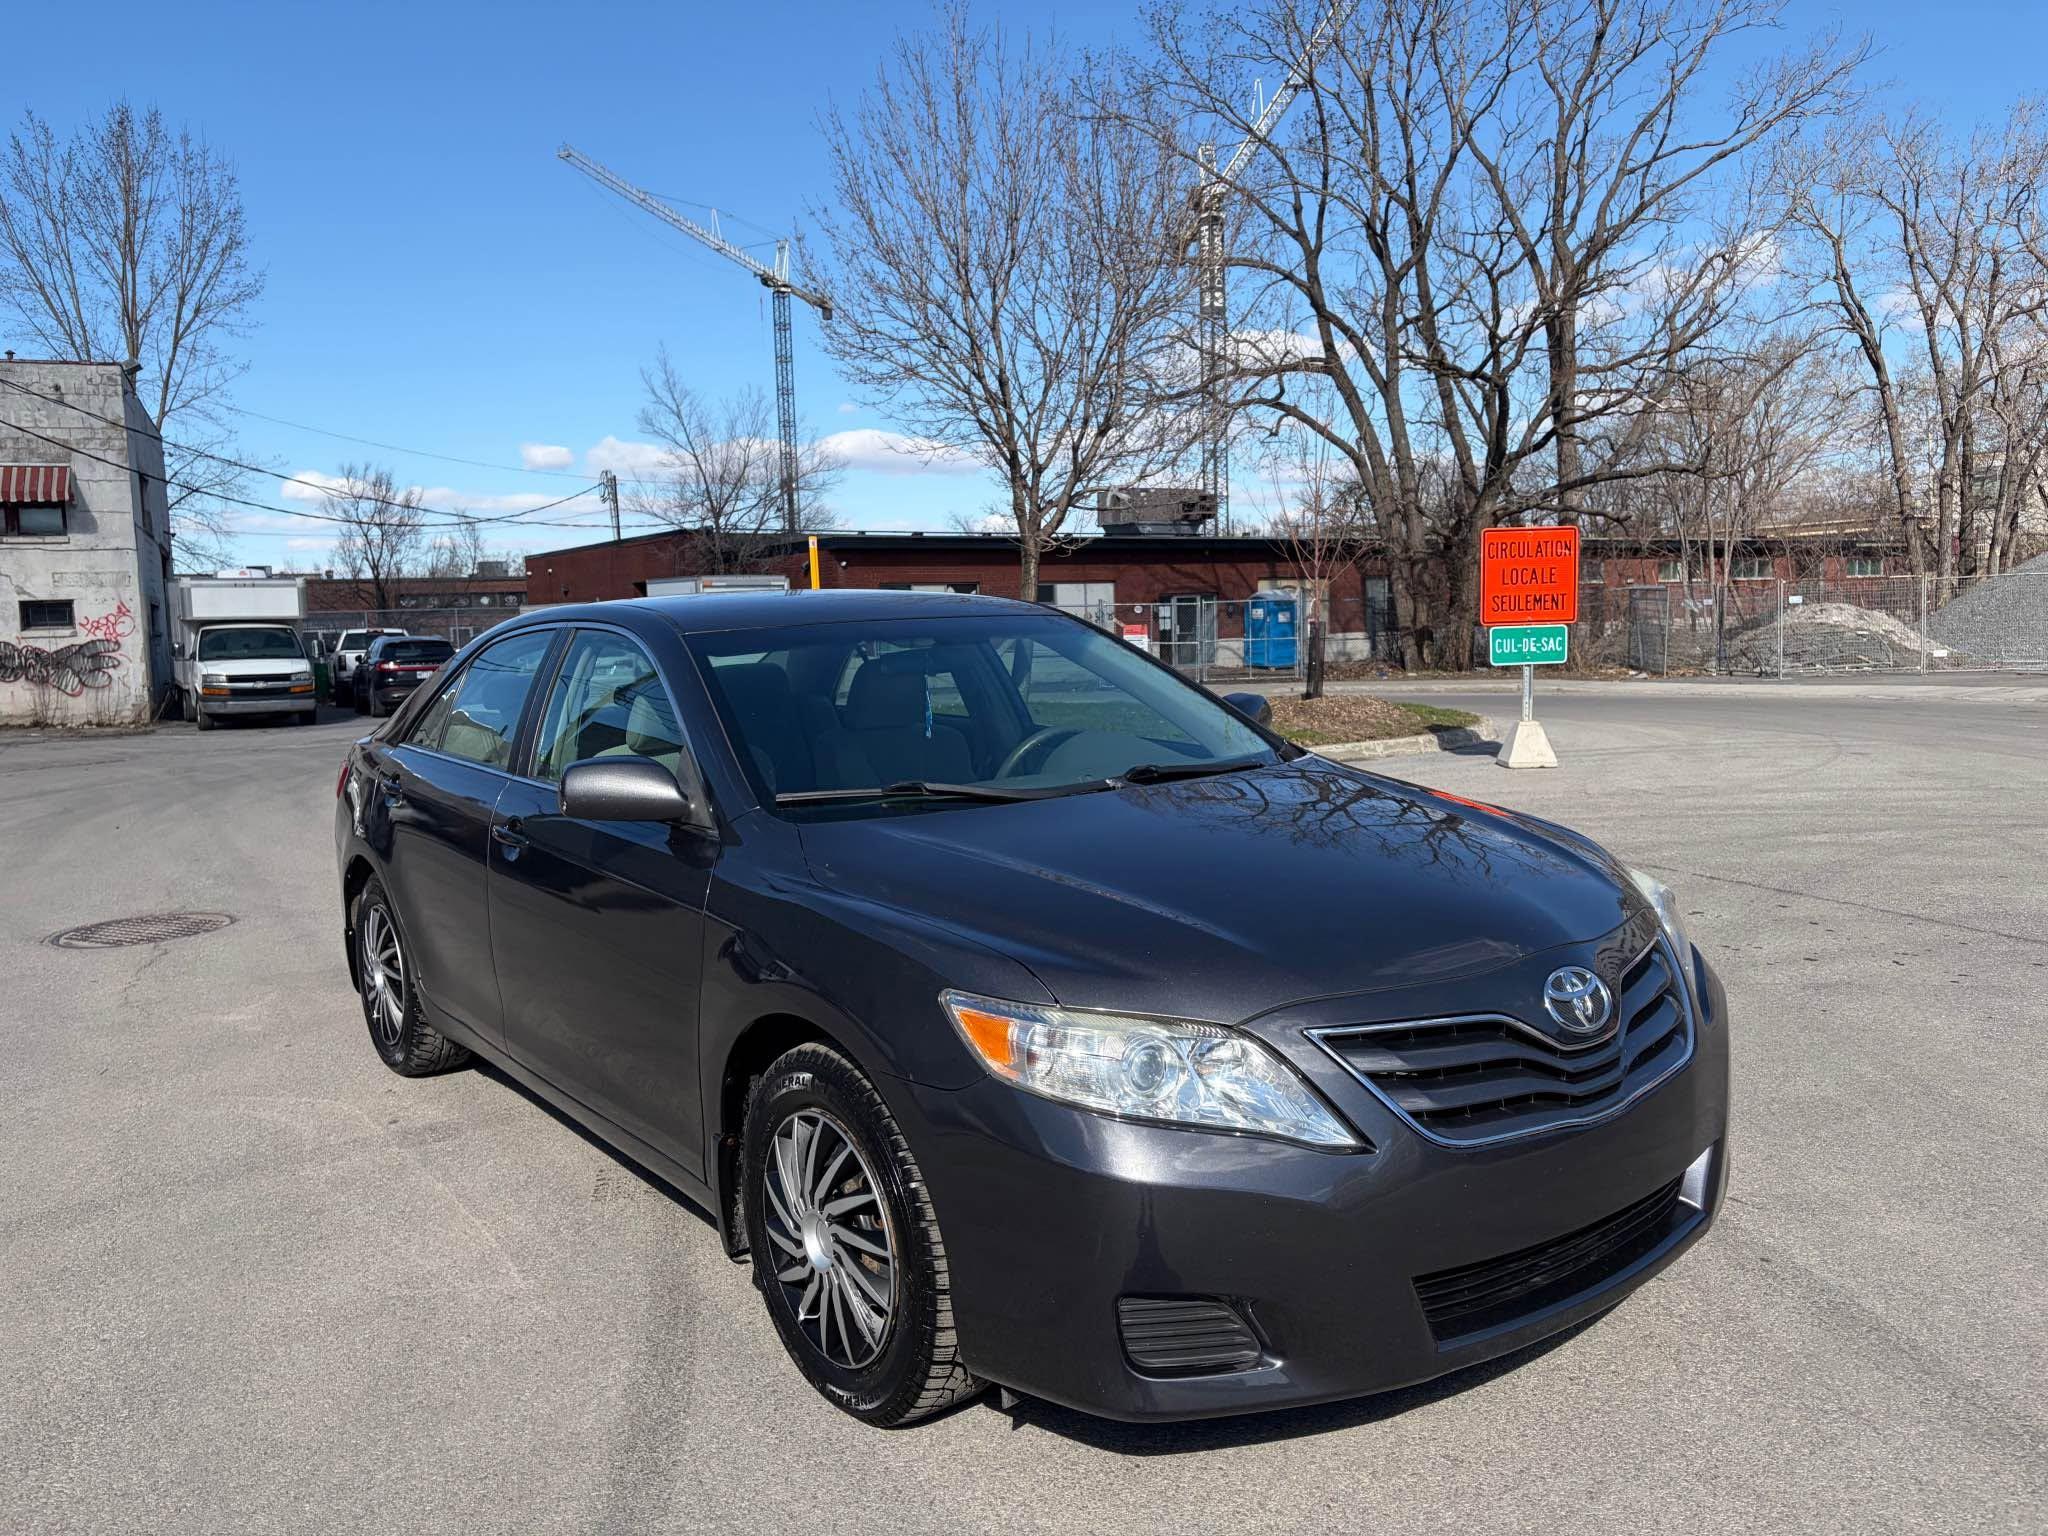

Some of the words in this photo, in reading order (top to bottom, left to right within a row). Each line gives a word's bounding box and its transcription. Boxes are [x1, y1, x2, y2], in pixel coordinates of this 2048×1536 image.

[1488, 540, 1572, 559] CIRCULATION
[1502, 567, 1557, 585] LOCALE
[1492, 593, 1567, 612] SEULEMENT
[1495, 637, 1562, 654] CUL-DE-SAC
